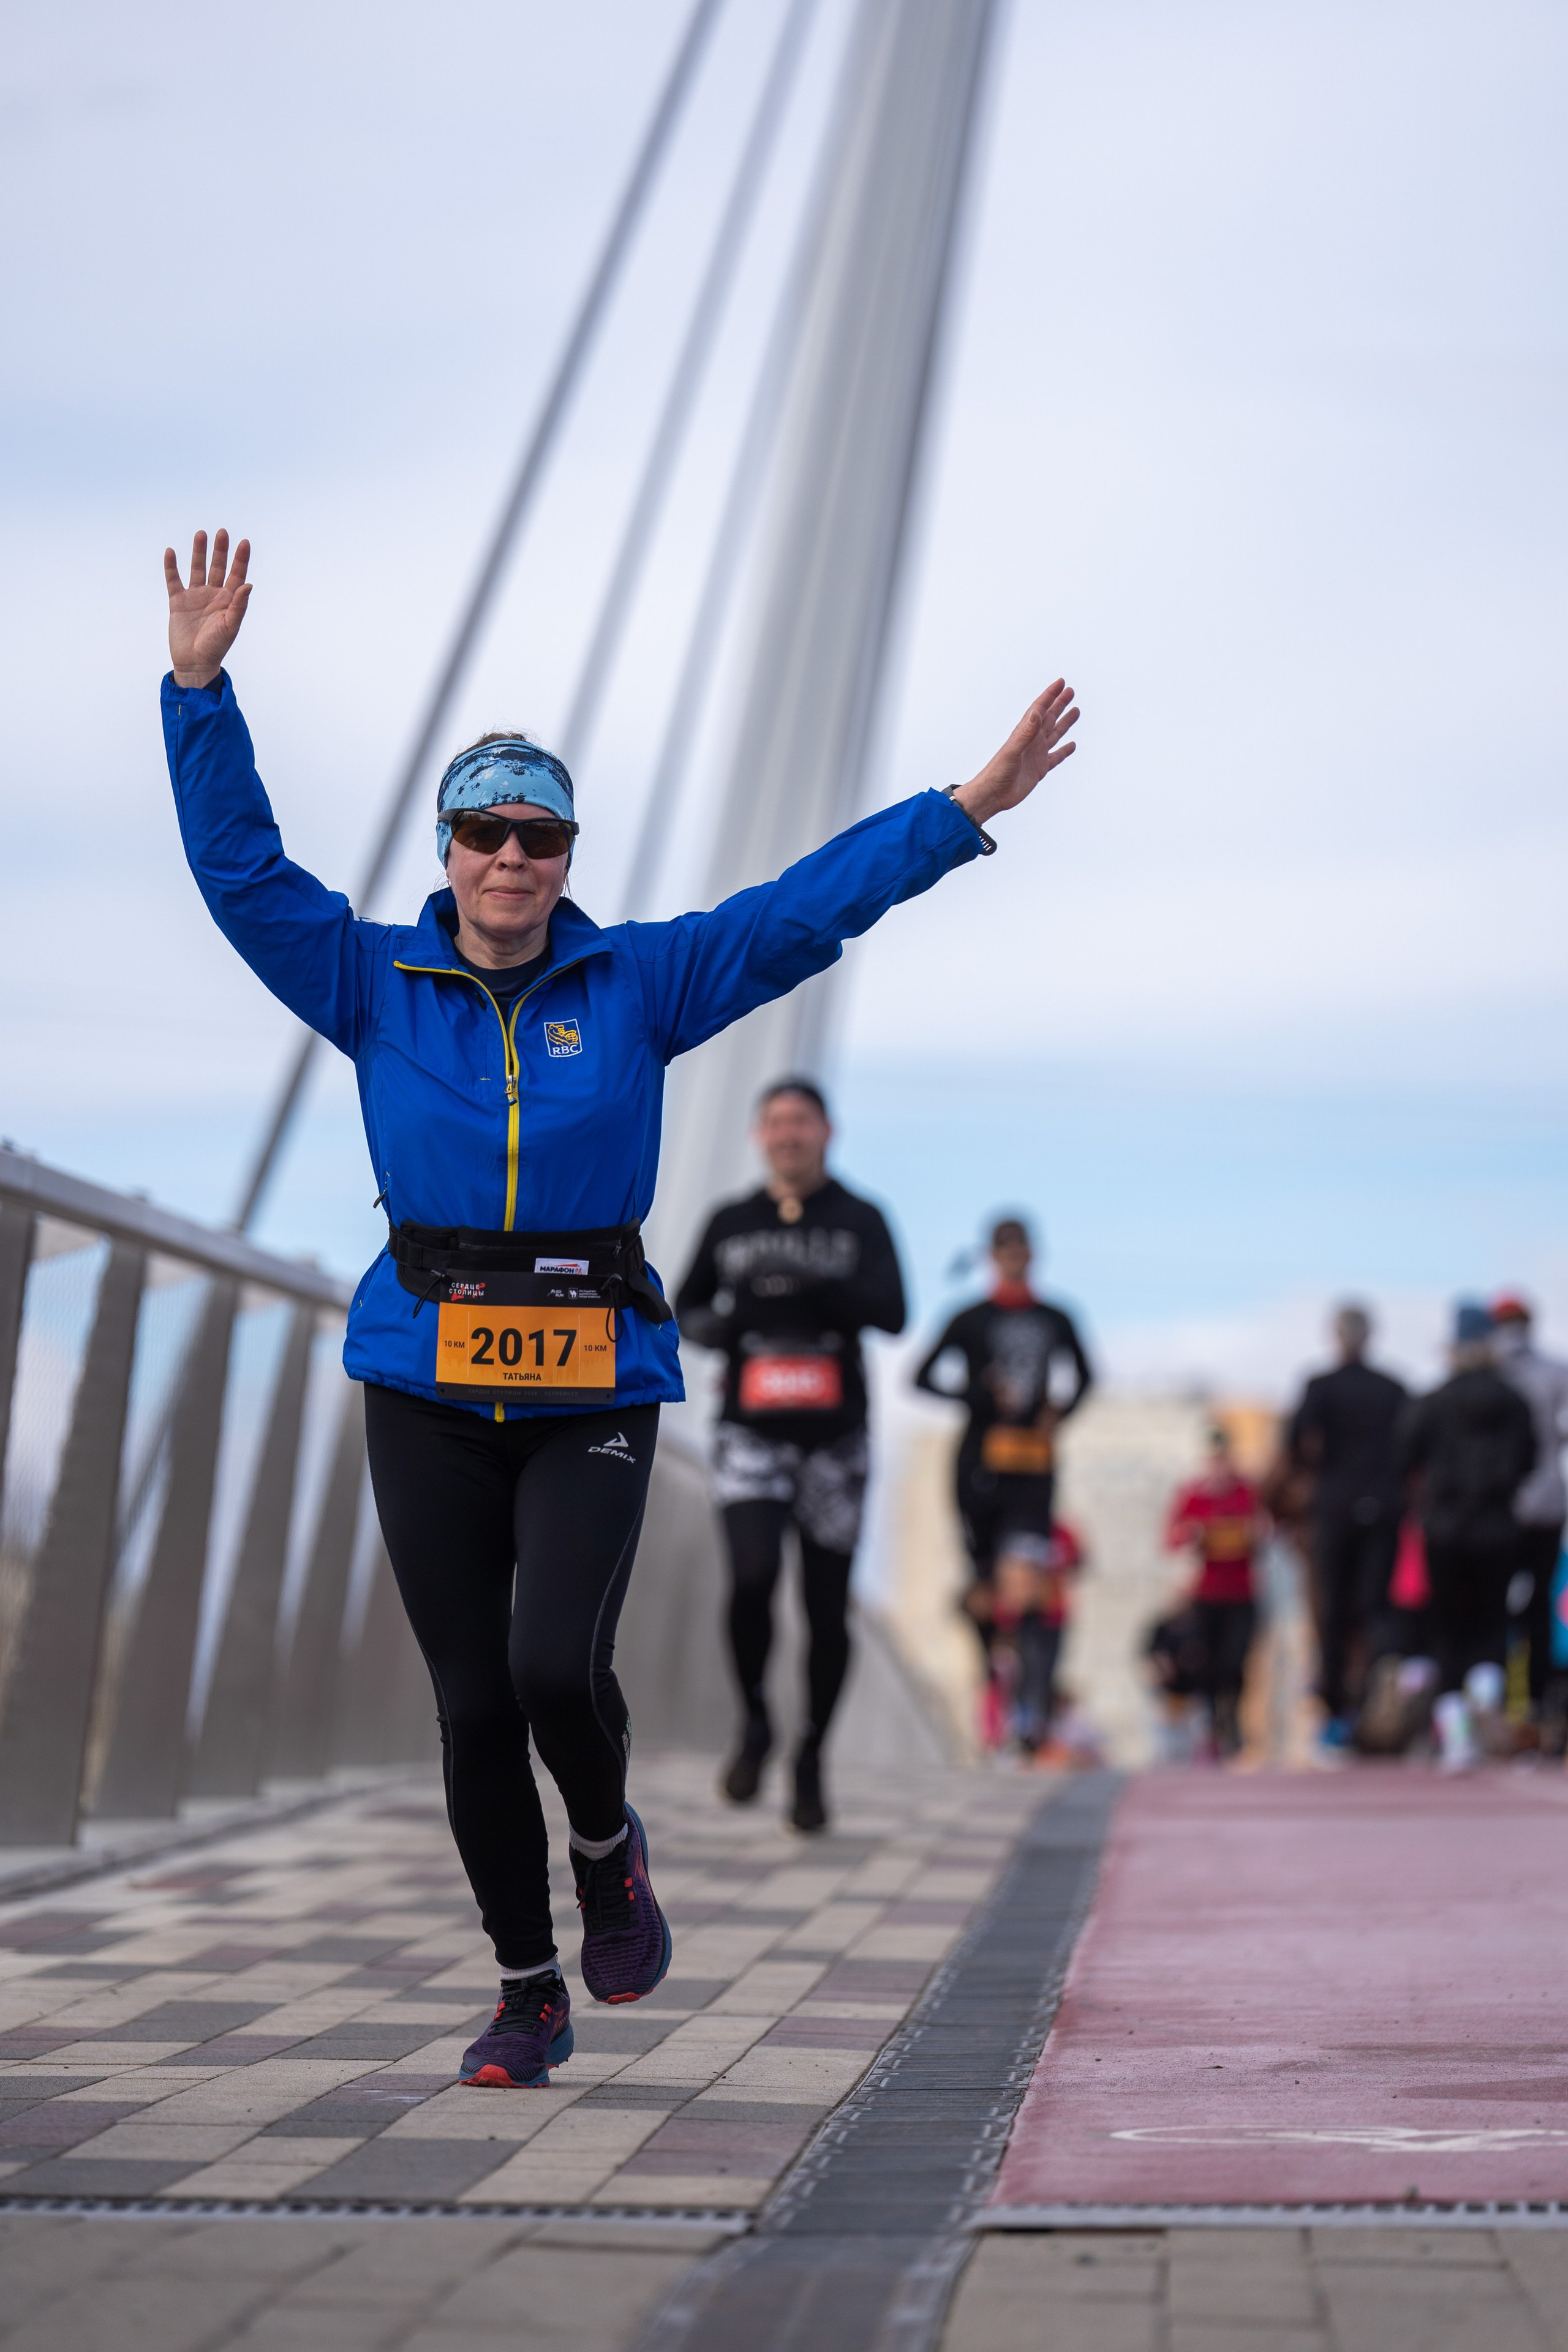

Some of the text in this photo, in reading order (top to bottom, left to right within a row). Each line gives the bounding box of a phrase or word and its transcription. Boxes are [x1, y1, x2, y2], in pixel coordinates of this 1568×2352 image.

[552, 1044, 579, 1055] RBC
[449, 1288, 484, 1297] СТОЛИЦЫ
[470, 1327, 577, 1366] 2017
[503, 1373, 541, 1381] ТАТЬЯНА
[587, 1446, 636, 1464] DEMIX
